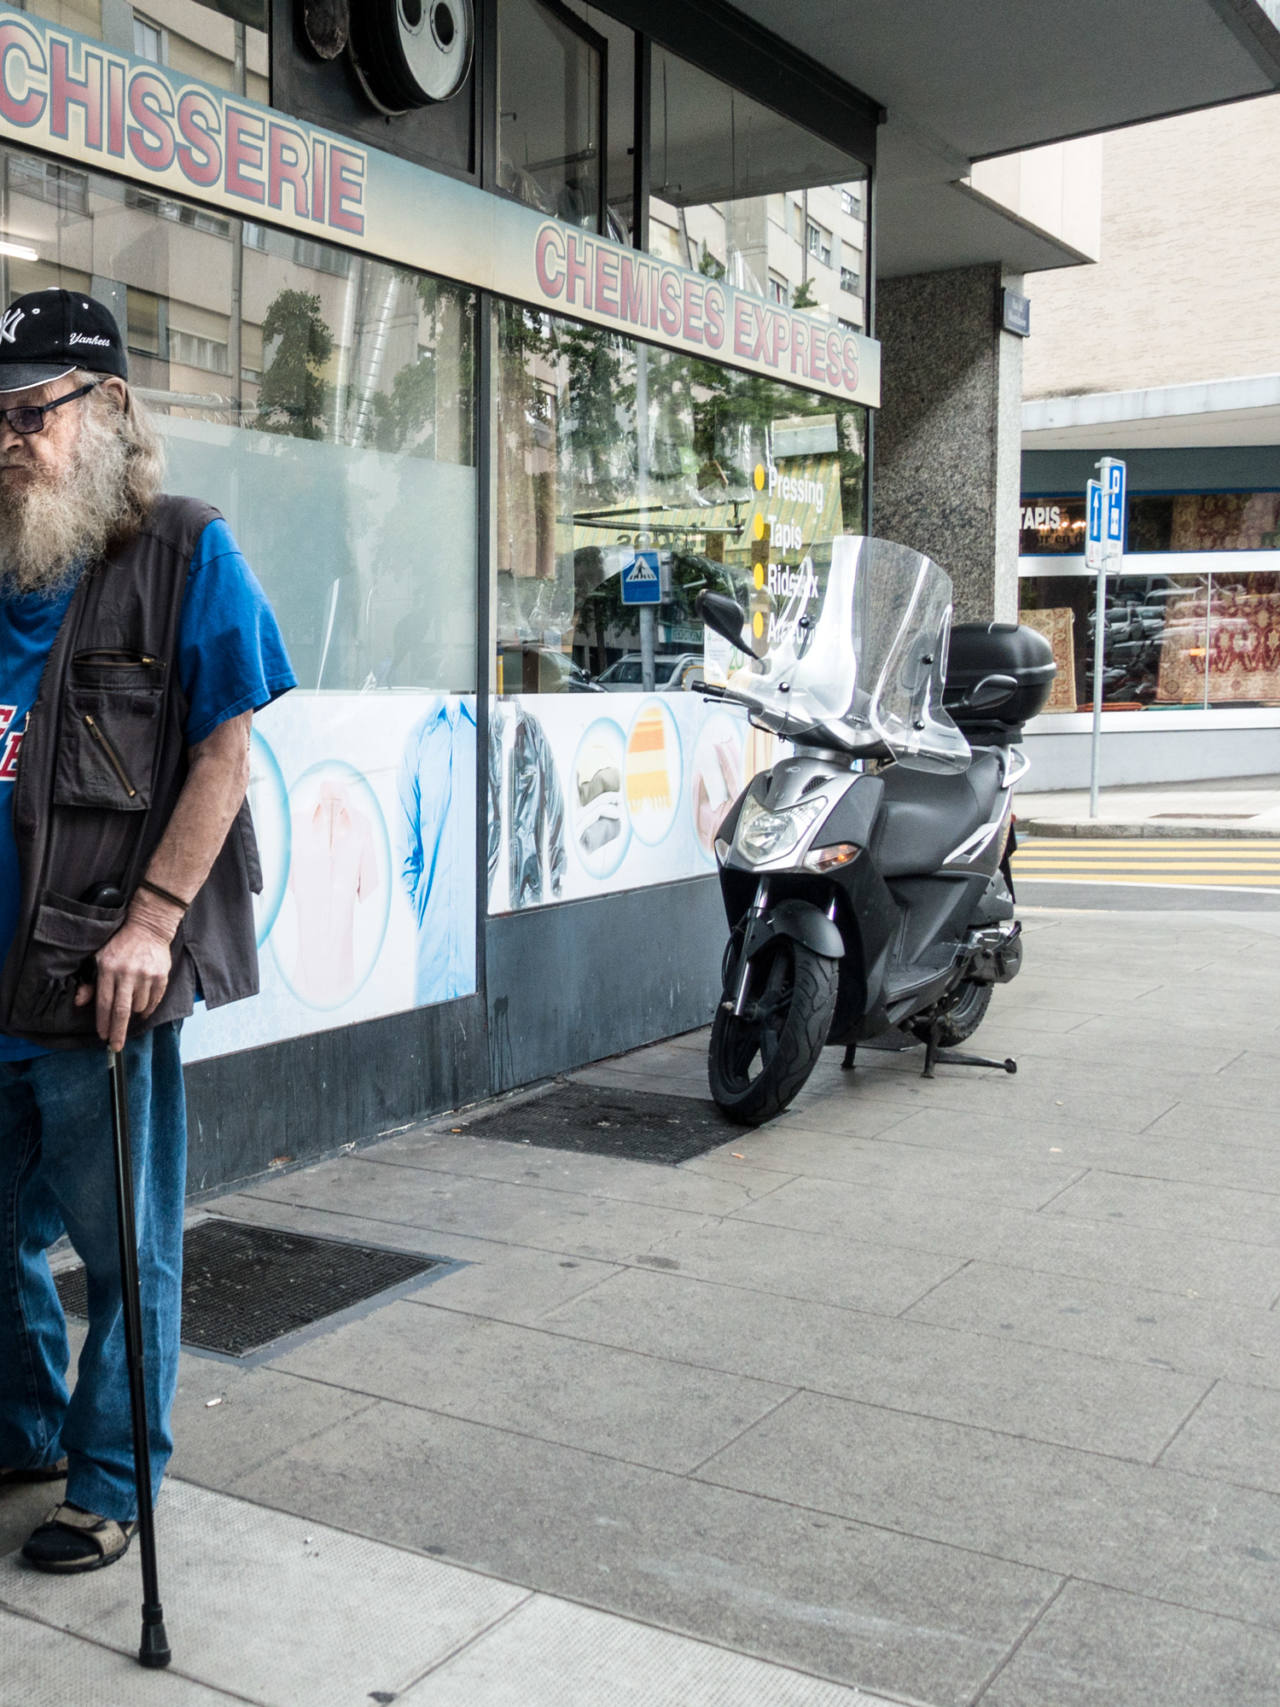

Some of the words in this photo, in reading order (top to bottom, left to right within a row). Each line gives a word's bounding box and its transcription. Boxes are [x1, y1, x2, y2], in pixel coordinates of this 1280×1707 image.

[535, 224, 726, 350] CHEMISES
[733, 296, 859, 393] EXPRESS
[69, 332, 111, 347] Yankees
[768, 465, 825, 513] Pressing
[1111, 469, 1120, 506] P
[768, 514, 803, 556] Tapis
